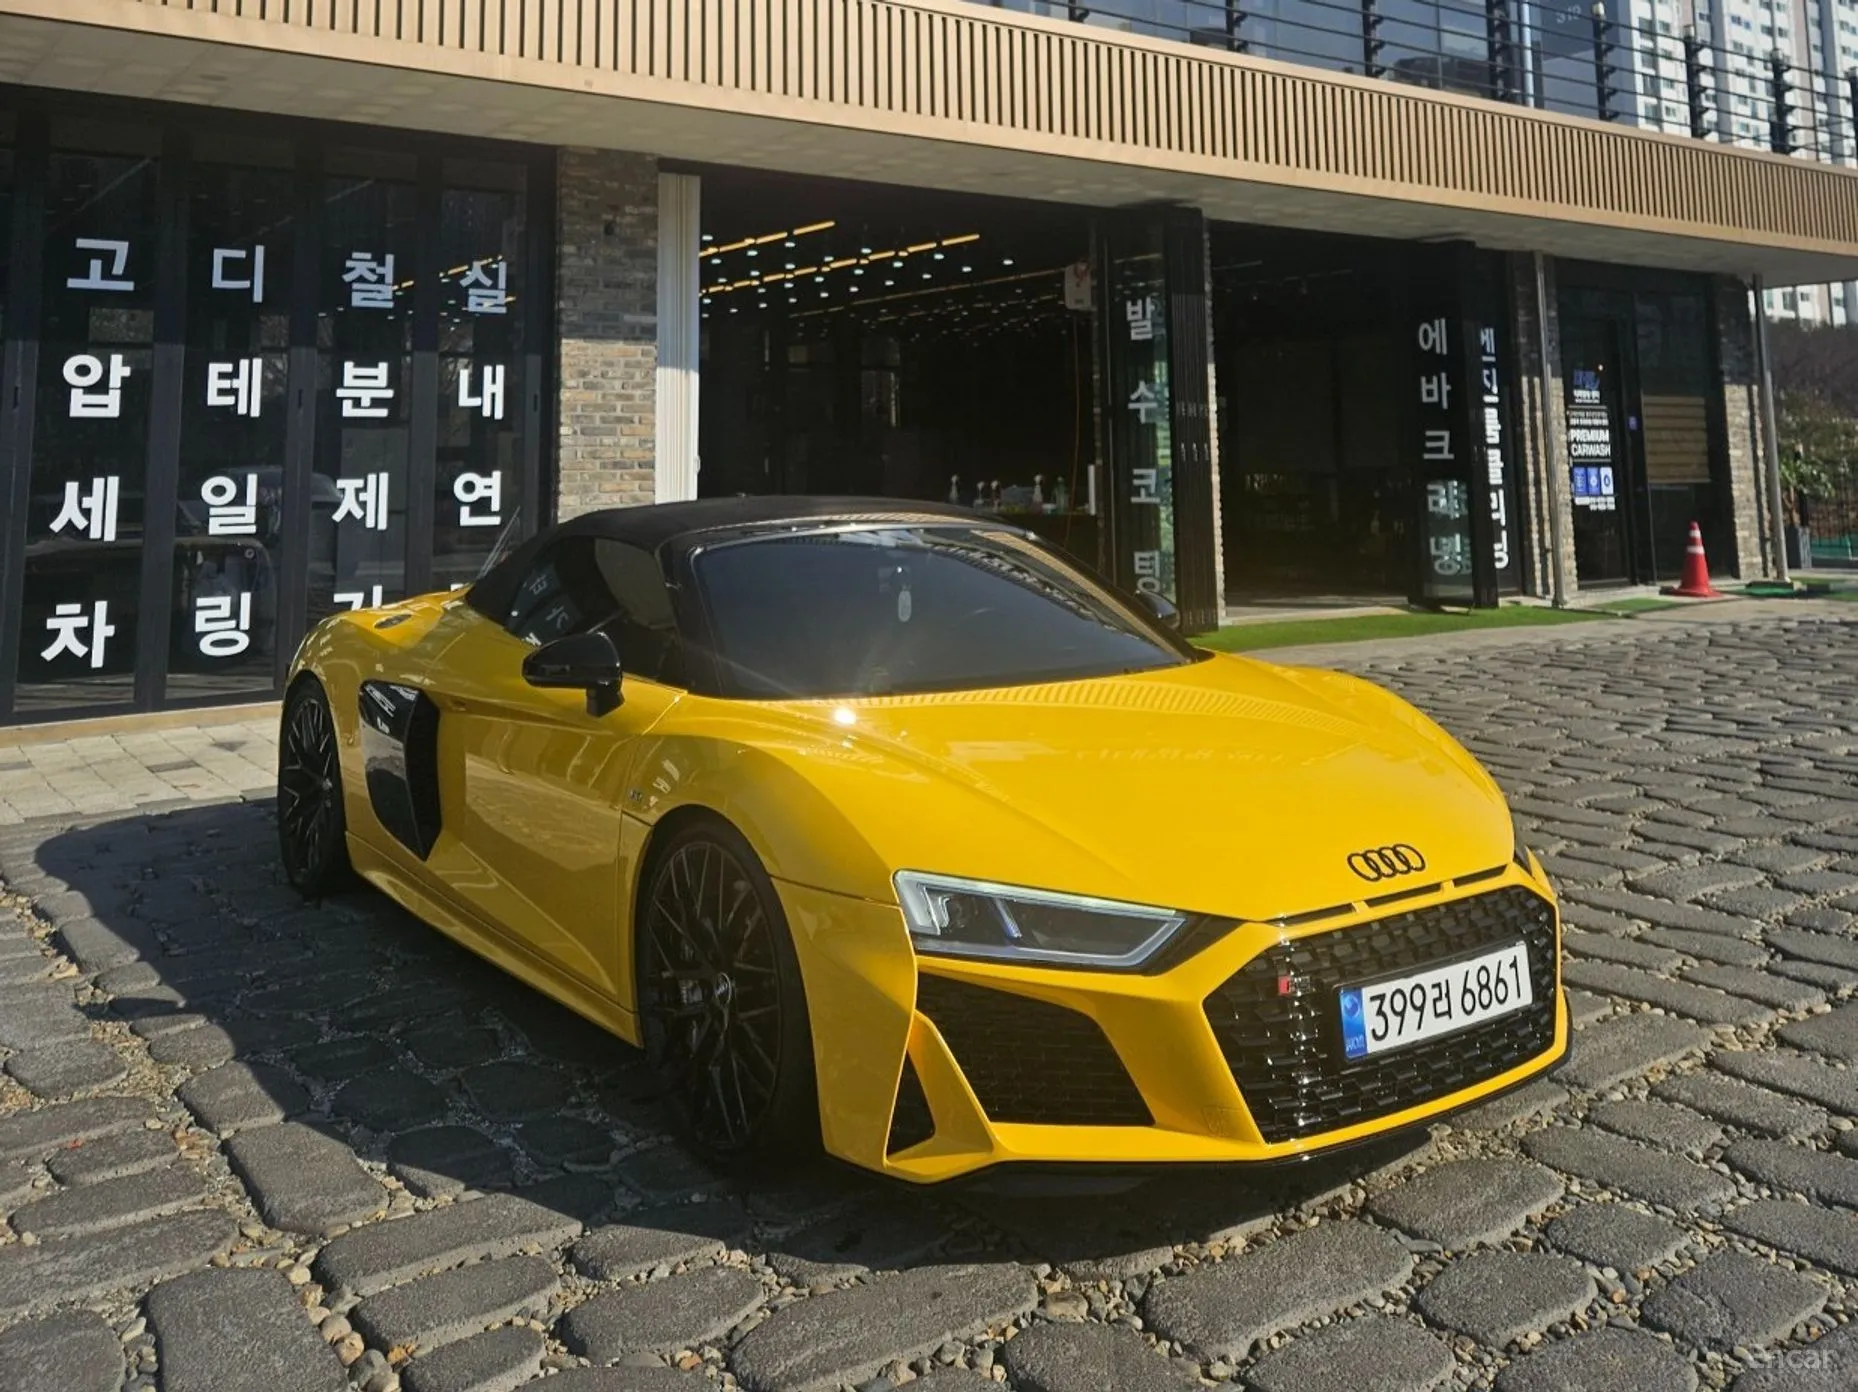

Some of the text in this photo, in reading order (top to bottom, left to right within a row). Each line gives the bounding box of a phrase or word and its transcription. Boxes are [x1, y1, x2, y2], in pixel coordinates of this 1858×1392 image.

[41, 237, 135, 669] 고압세차
[194, 245, 265, 657] 디테일링
[450, 259, 508, 593] 실내연
[1126, 297, 1161, 595] 발수코팅
[1569, 428, 1610, 442] PREMIUM
[1571, 443, 1611, 457] CARWASH
[1369, 955, 1522, 1042] 399러 6861
